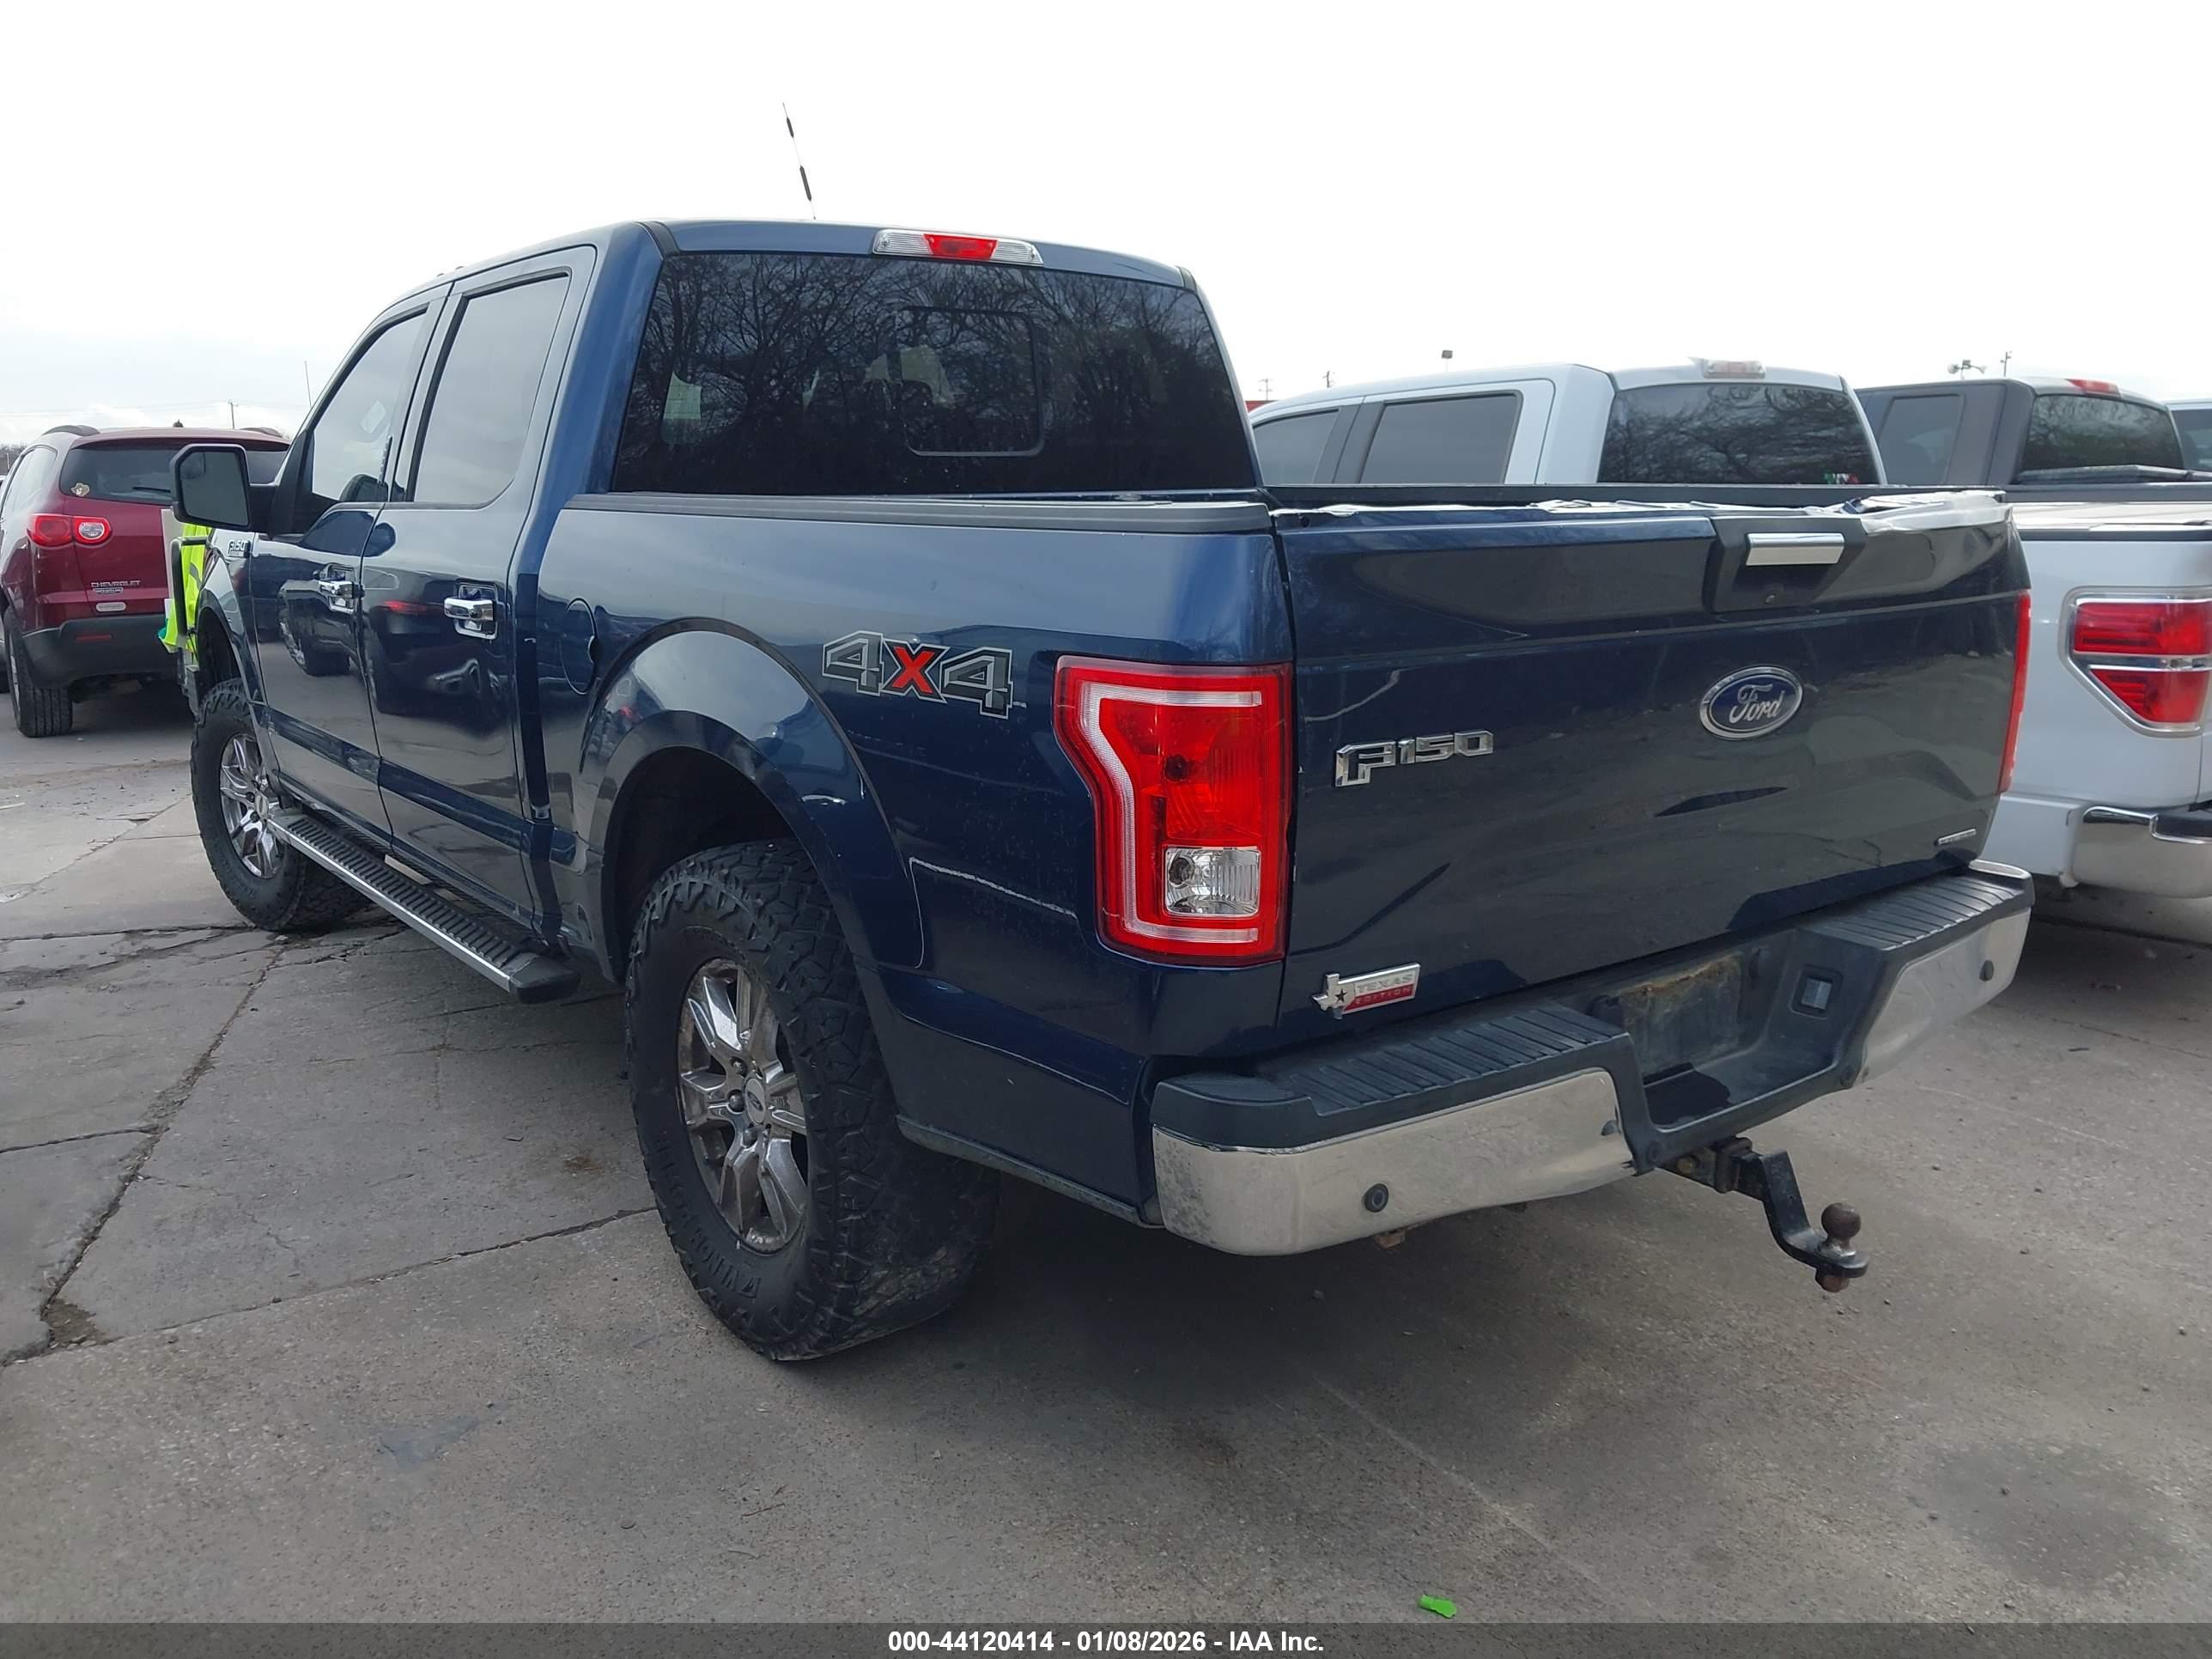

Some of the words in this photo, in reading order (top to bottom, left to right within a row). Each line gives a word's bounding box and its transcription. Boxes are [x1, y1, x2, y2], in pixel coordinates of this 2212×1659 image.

[822, 630, 1013, 719] 4X4
[1729, 684, 1786, 724] Ford
[1335, 730, 1494, 787] F150
[1354, 987, 1412, 1005] EDITION
[1355, 973, 1413, 994] TEXAS
